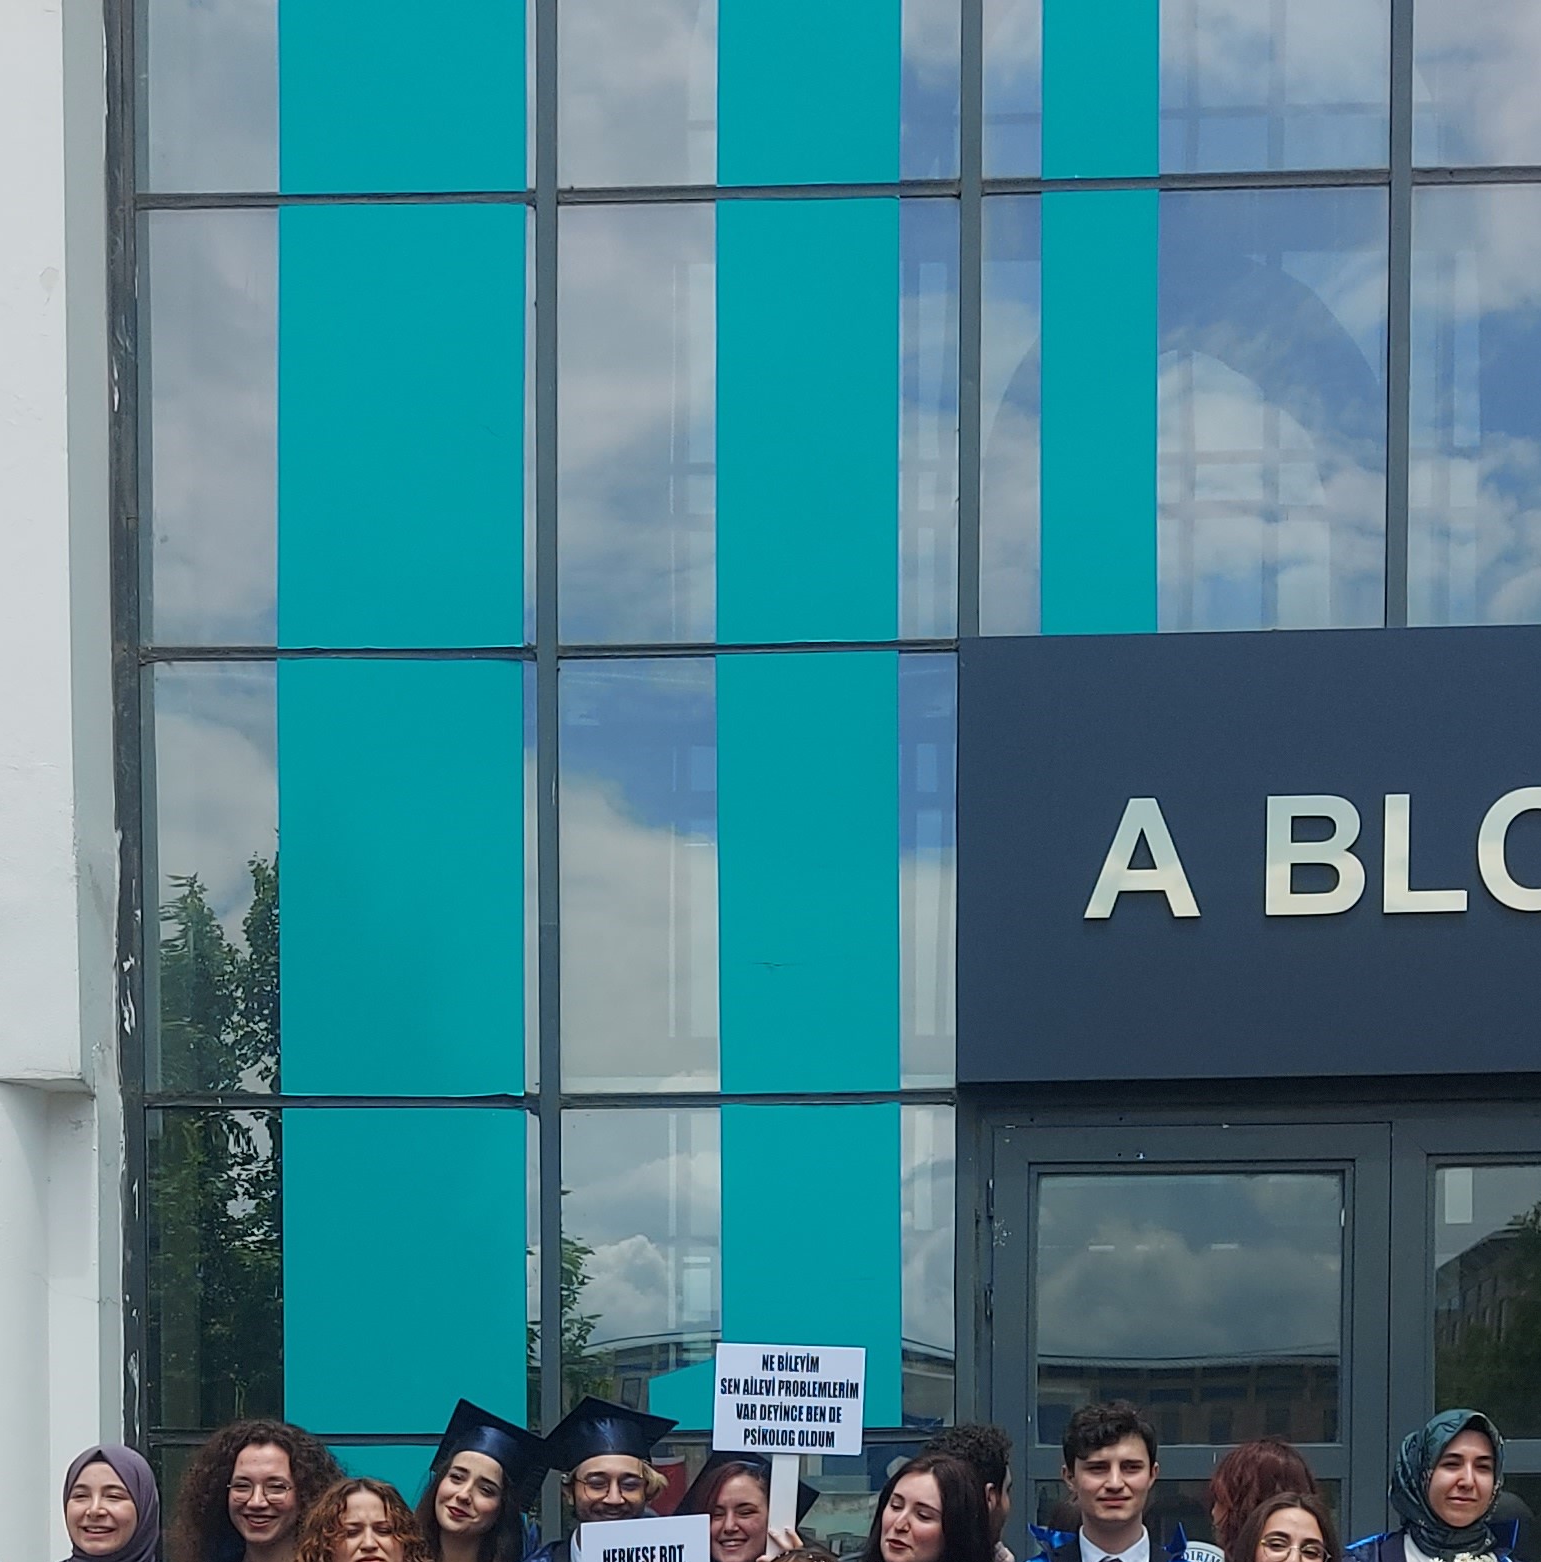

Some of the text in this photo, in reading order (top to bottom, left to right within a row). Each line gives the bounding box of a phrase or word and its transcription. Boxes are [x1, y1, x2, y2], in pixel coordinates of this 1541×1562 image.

[1083, 797, 1201, 920] A
[762, 1352, 819, 1373] NE BİLEYİM
[721, 1376, 859, 1399] SEN AİLEVİ PROBLEMLERİM
[736, 1402, 842, 1423] VAR DEYİNCE BEN DE
[744, 1426, 835, 1448] PSİKOLOG OLDUM
